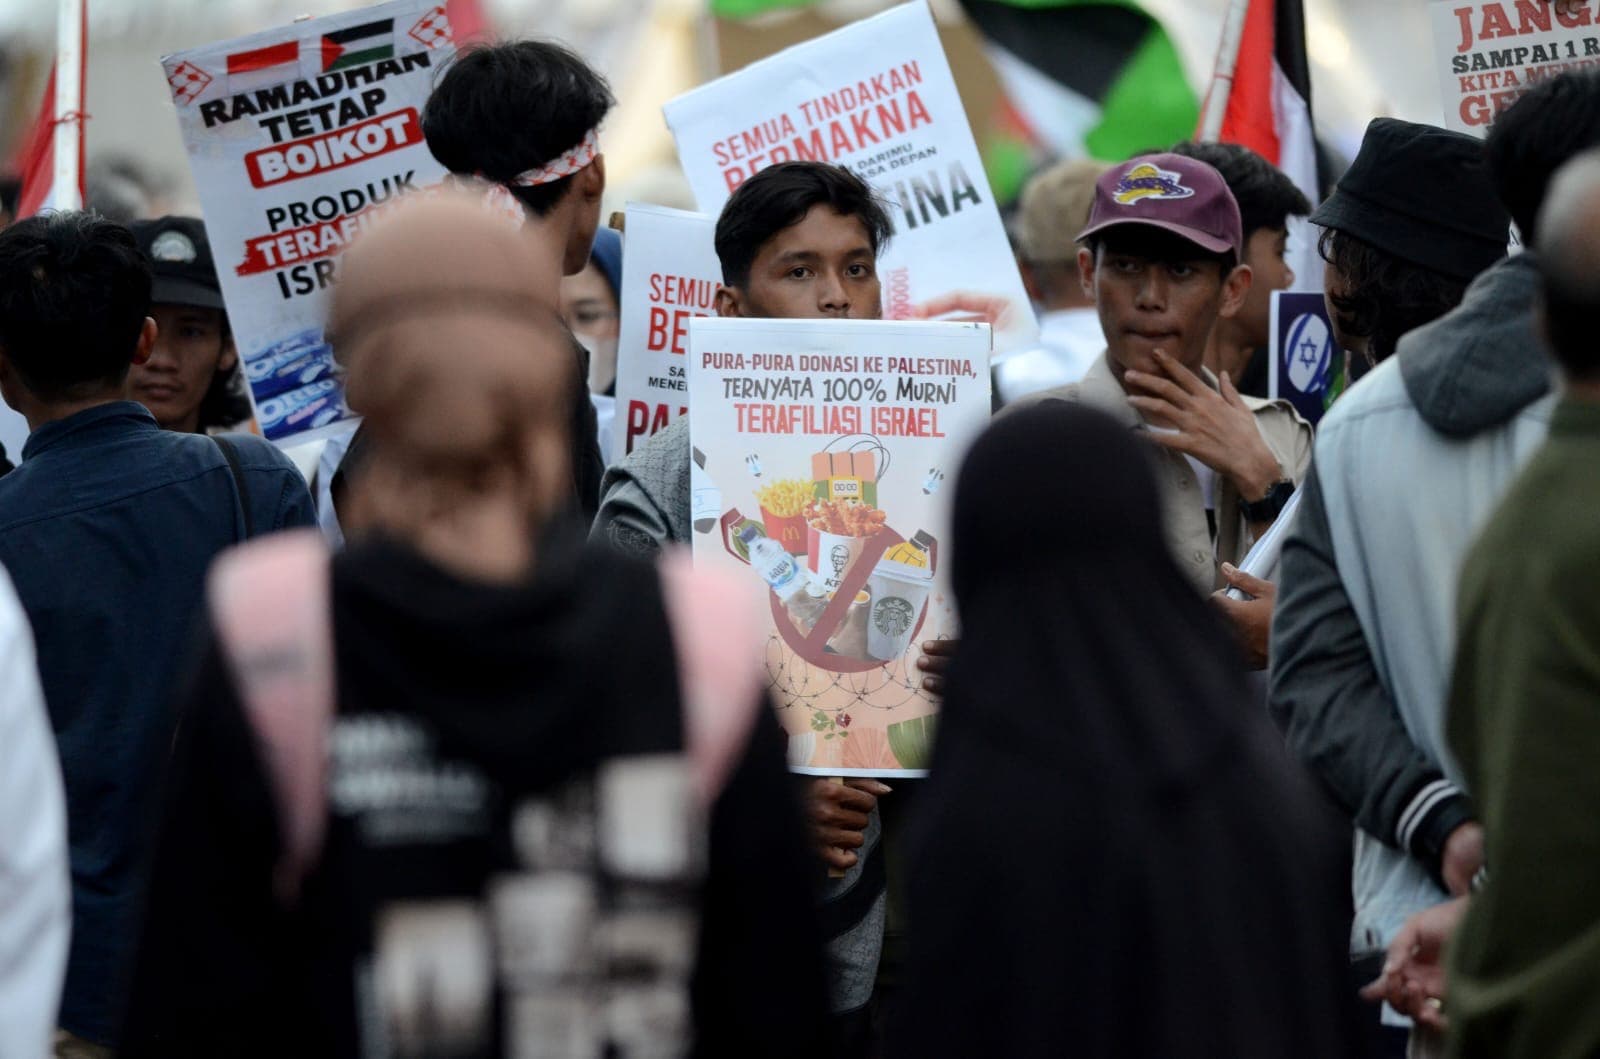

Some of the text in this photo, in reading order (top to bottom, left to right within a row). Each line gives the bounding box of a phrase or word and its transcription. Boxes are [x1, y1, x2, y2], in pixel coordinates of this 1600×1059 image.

[1454, 0, 1600, 53] JANG
[1452, 37, 1600, 74] SAMPAI 1 R
[200, 51, 431, 128] RAMADHAN
[1459, 69, 1520, 93] KITA
[259, 88, 387, 143] TETAP
[712, 60, 923, 166] SEMUA TINDAKAN
[255, 113, 411, 183] BOIKOT
[857, 143, 912, 169] DARIMU
[889, 146, 938, 169] DEPAN
[266, 170, 418, 233] PRODUK
[277, 259, 338, 299] ISR
[648, 307, 708, 355] BE
[648, 376, 688, 392] MENE
[668, 366, 686, 378] SA
[702, 352, 977, 379] PURA-PURA DONASI KE PALESTINA,
[722, 376, 814, 401] TERNYATA
[823, 377, 887, 403] 100%
[626, 399, 688, 456] PA
[734, 403, 945, 437] TERAFILIASI ISRAEL
[825, 578, 843, 589] KF
